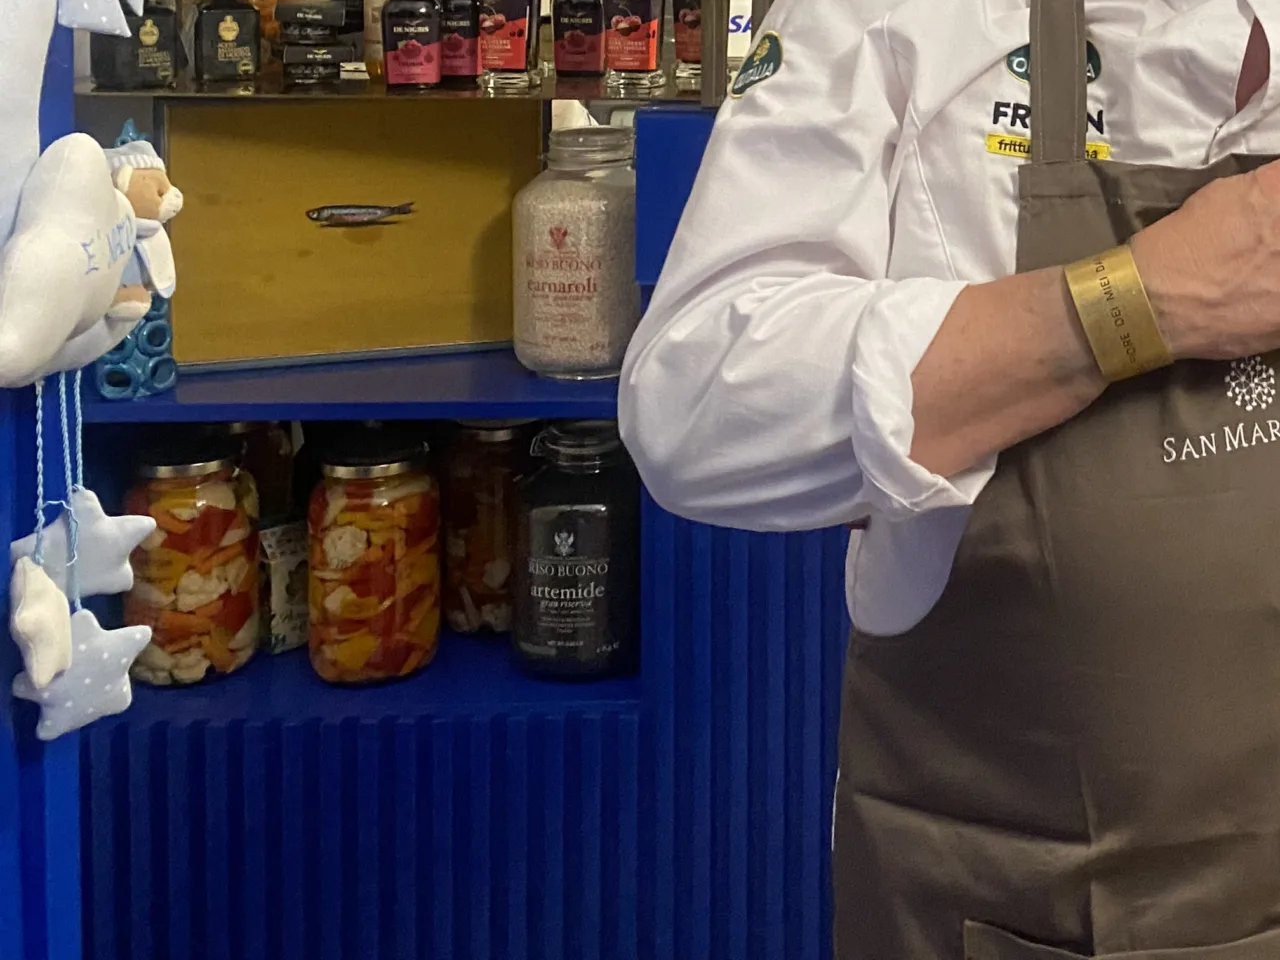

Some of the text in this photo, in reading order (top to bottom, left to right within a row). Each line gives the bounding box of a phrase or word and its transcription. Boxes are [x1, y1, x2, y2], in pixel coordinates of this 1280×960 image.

[527, 277, 598, 294] carnaroli
[1162, 433, 1218, 463] SAN
[528, 562, 609, 577] RISO BUONO
[530, 581, 606, 600] artemide
